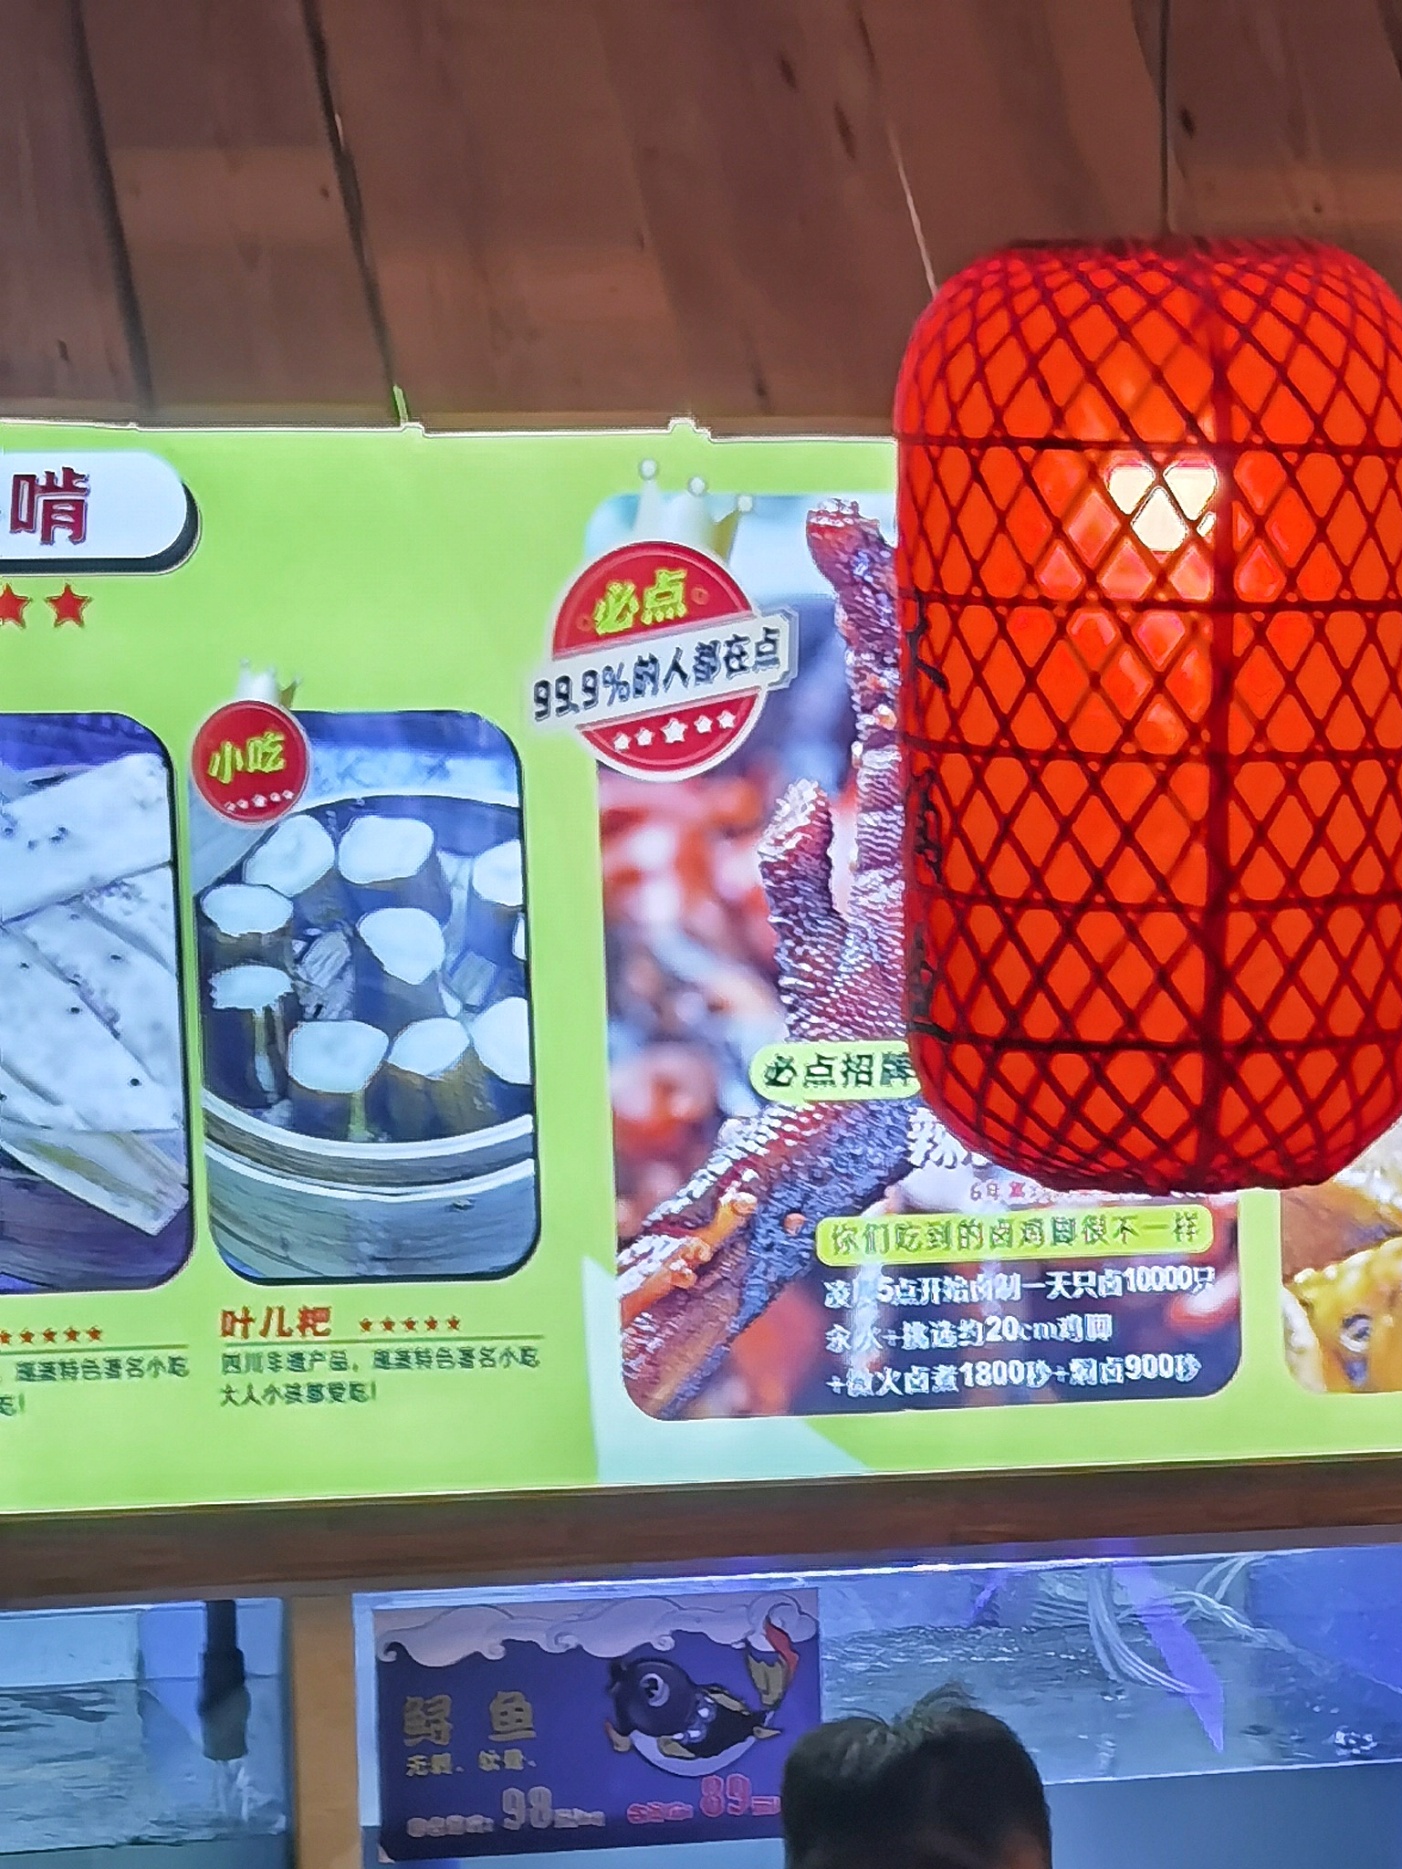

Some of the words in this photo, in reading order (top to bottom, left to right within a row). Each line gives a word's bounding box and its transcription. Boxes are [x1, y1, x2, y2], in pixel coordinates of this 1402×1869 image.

[9, 466, 91, 545] 啃
[594, 569, 688, 635] 必点
[533, 627, 781, 721] 99.9%的人都在点
[208, 731, 286, 784] 小吃
[220, 1306, 332, 1339] 叶儿粑
